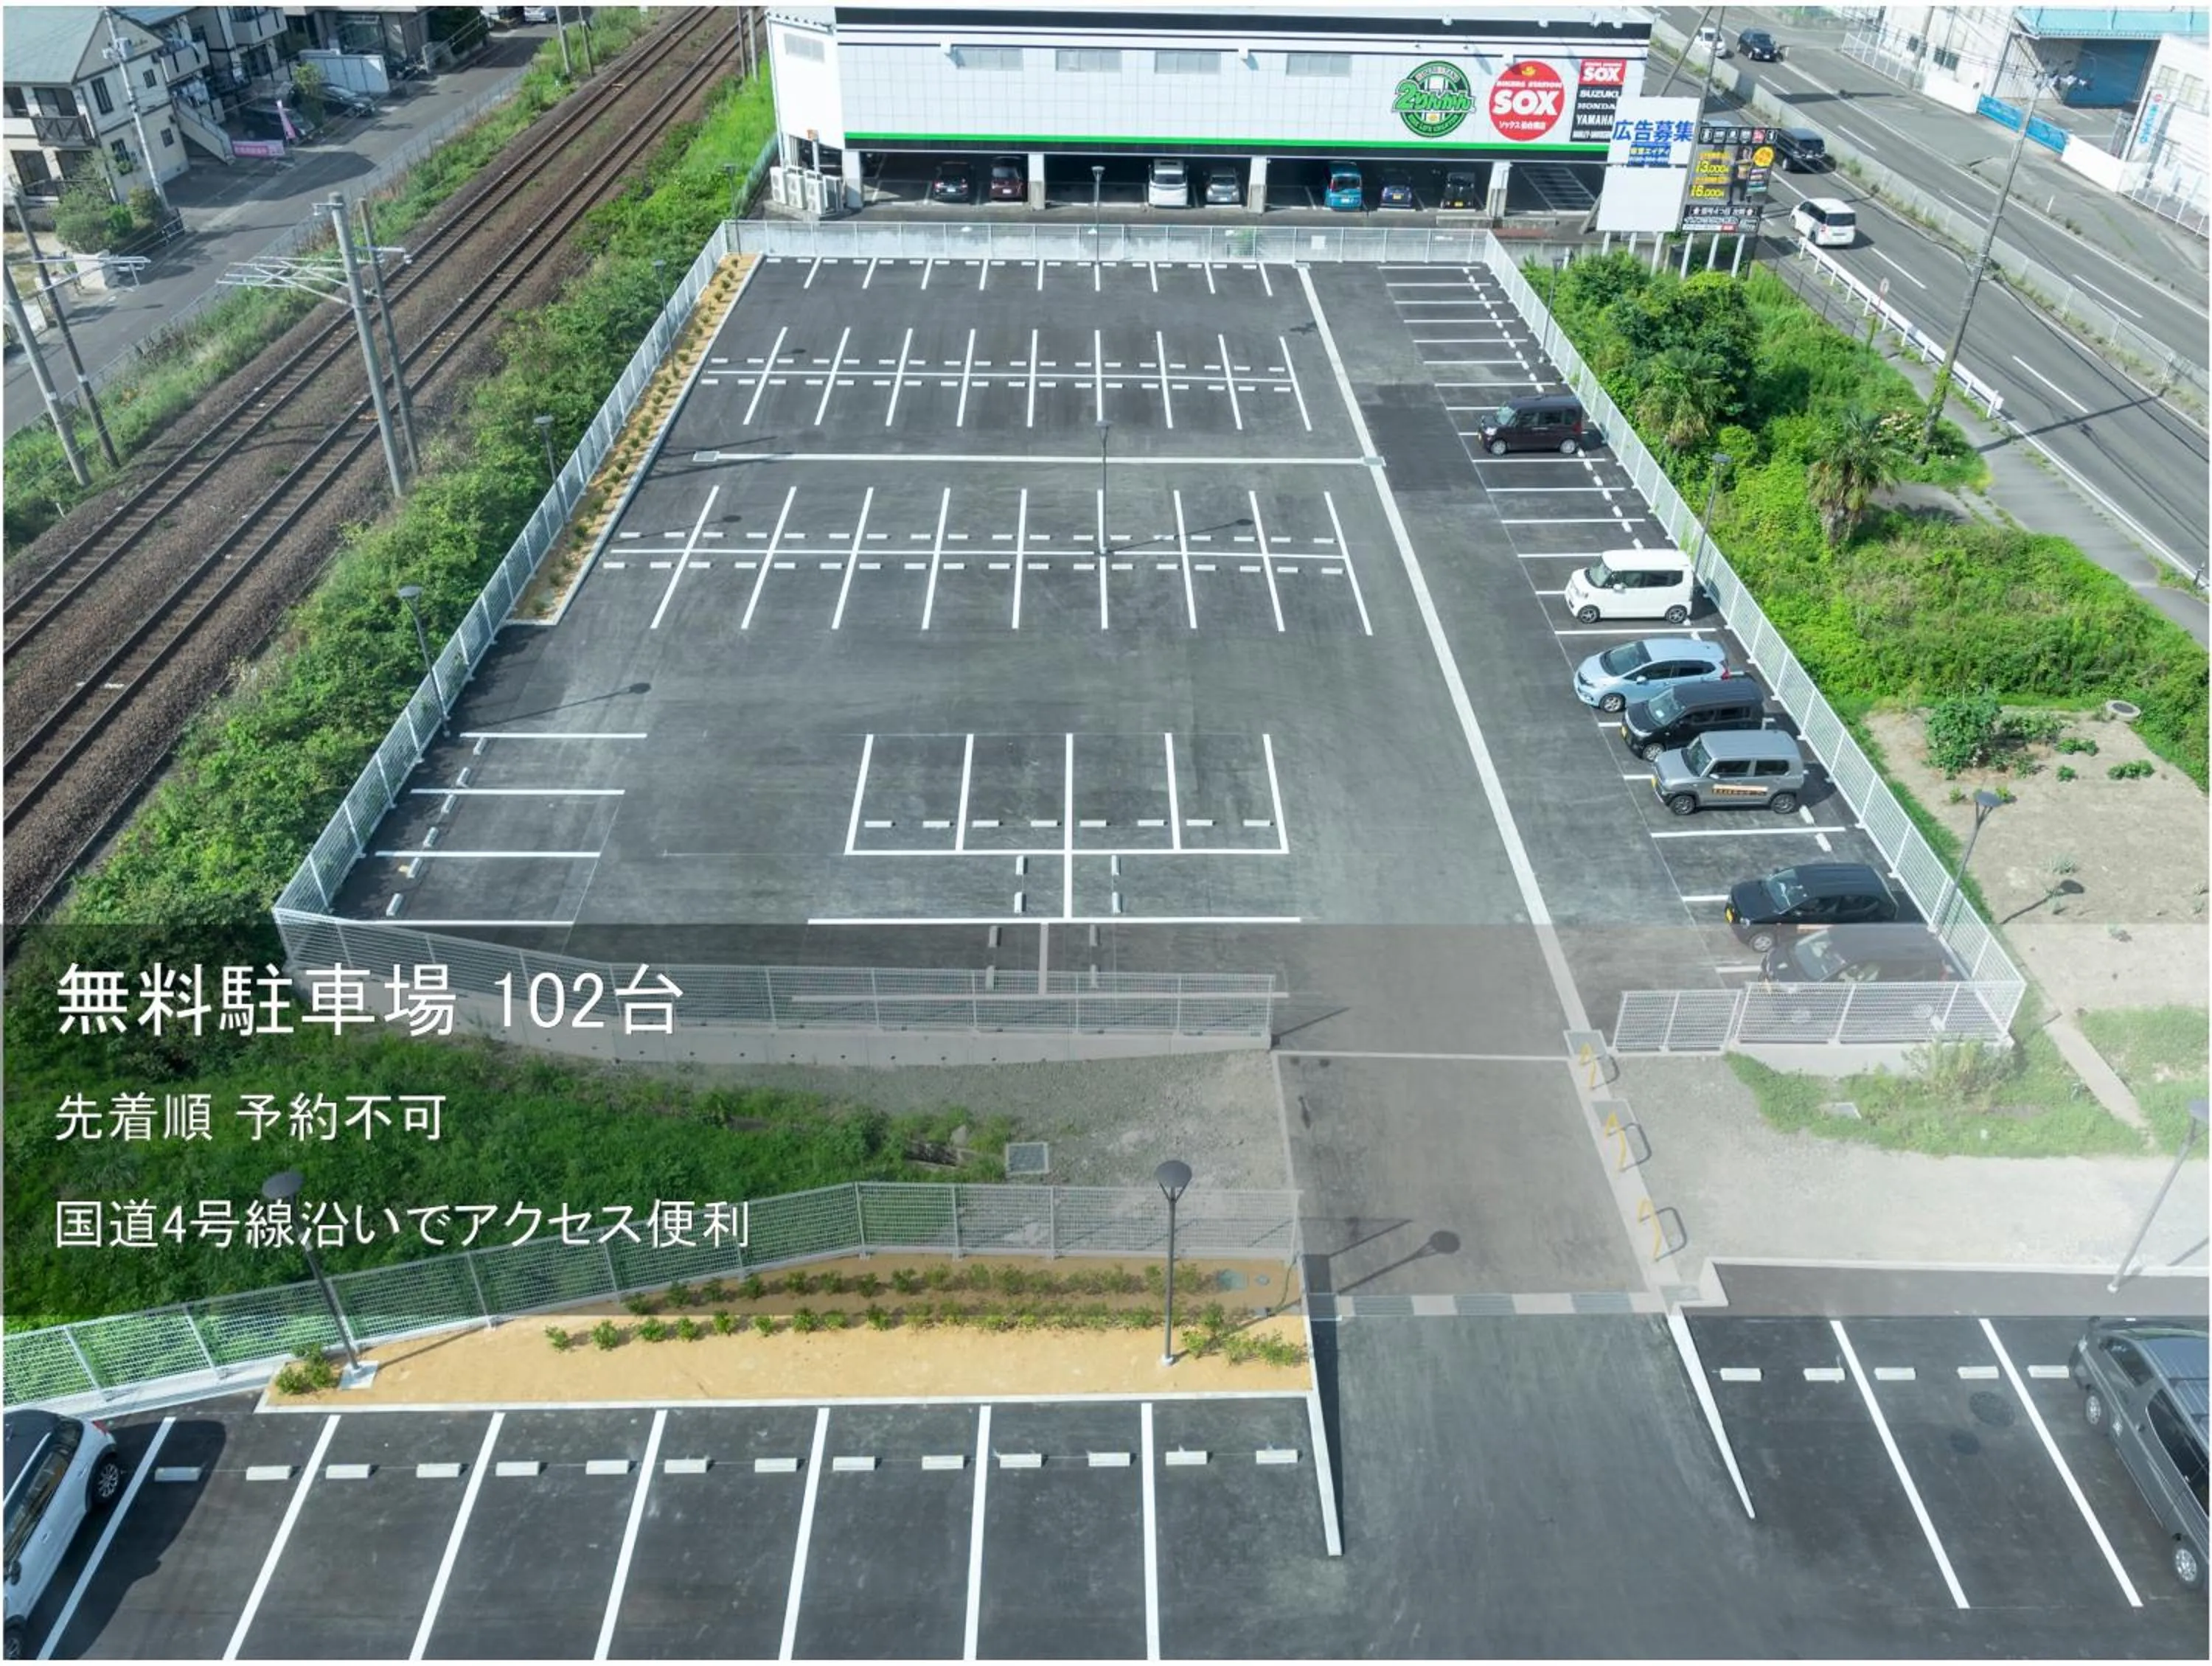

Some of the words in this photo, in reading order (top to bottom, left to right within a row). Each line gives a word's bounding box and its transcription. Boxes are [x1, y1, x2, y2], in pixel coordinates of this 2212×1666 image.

[1583, 67, 1621, 82] SOX
[1579, 89, 1620, 97] SUZUKI
[1492, 89, 1560, 115] SOX
[1577, 114, 1615, 125] YAMAHA
[1612, 119, 1694, 142] 広告募集
